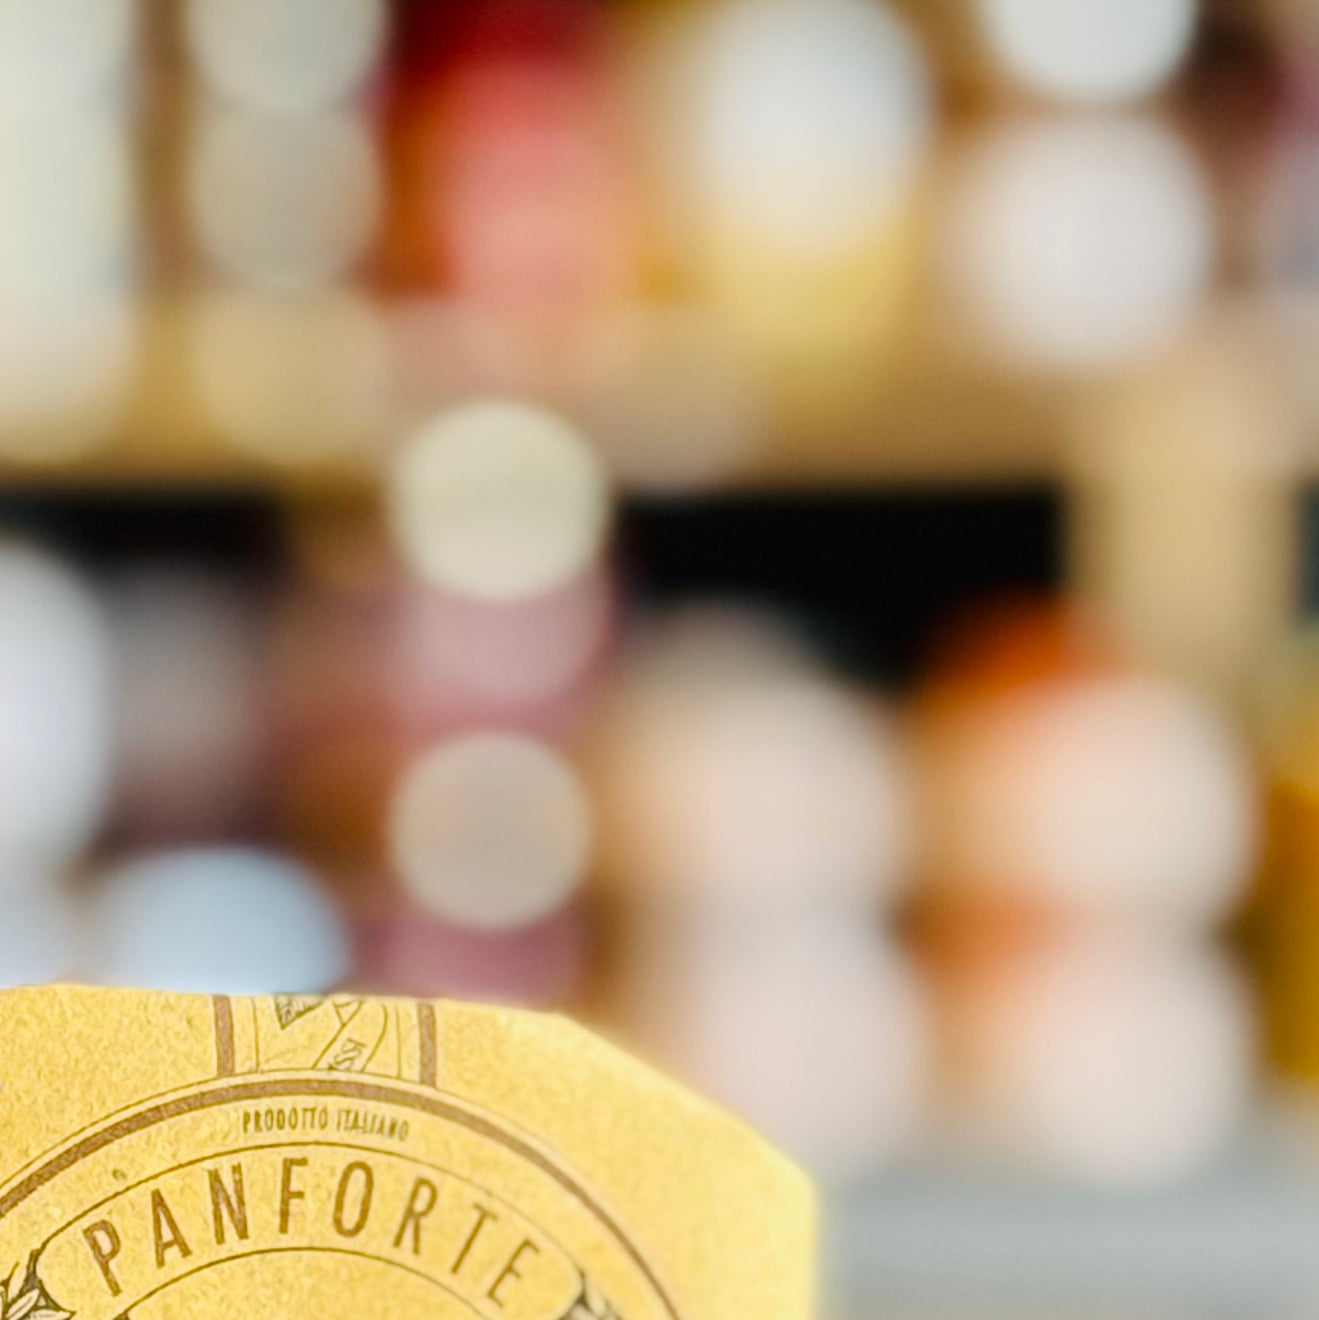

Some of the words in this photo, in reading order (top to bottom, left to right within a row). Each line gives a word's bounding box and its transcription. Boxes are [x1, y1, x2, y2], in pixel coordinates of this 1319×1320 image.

[242, 1106, 329, 1134] PRODOTTO
[336, 1108, 409, 1142] ITALIANO
[81, 1156, 541, 1310] PANFORTE
